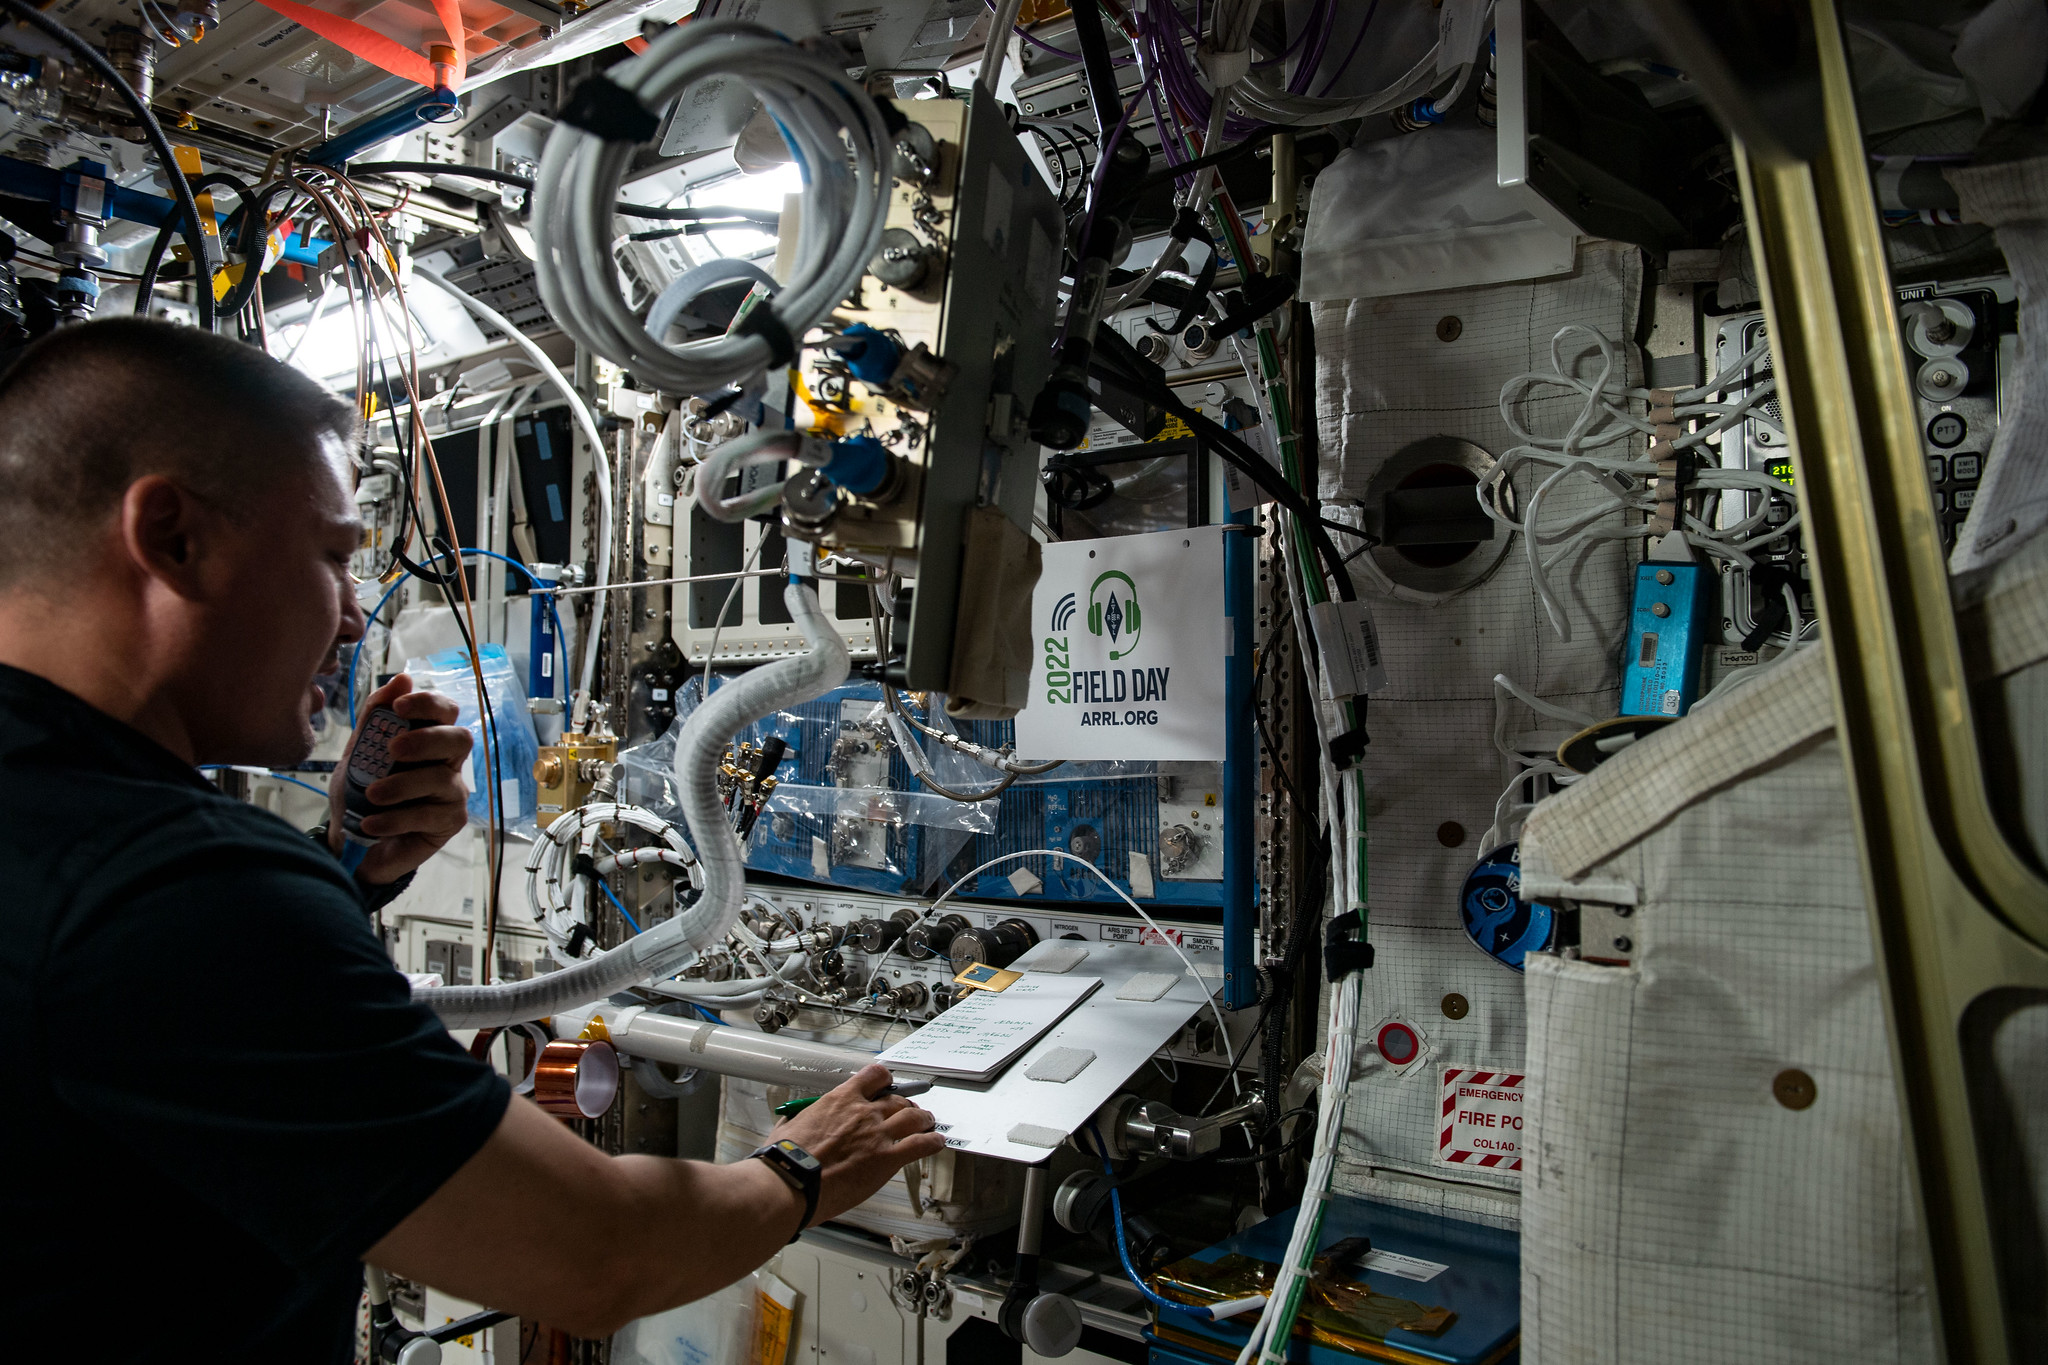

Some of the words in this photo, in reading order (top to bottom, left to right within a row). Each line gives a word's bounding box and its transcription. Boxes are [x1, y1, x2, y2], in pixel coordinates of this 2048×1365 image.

[1901, 288, 1926, 300] UNIT
[1937, 426, 1957, 435] PTT
[1044, 636, 1071, 705] 2022
[1072, 669, 1126, 704] FIELD
[1131, 667, 1170, 702] DAY
[1666, 695, 1677, 708] 33
[1080, 710, 1158, 727] ARRL.ORG
[1054, 923, 1079, 932] NITROGEN
[1107, 926, 1121, 934] ARIS
[1192, 937, 1214, 945] SMOKE
[1459, 1088, 1524, 1102] EMERGENCY
[1458, 1110, 1496, 1128] FIRE
[1501, 1115, 1524, 1131] PO
